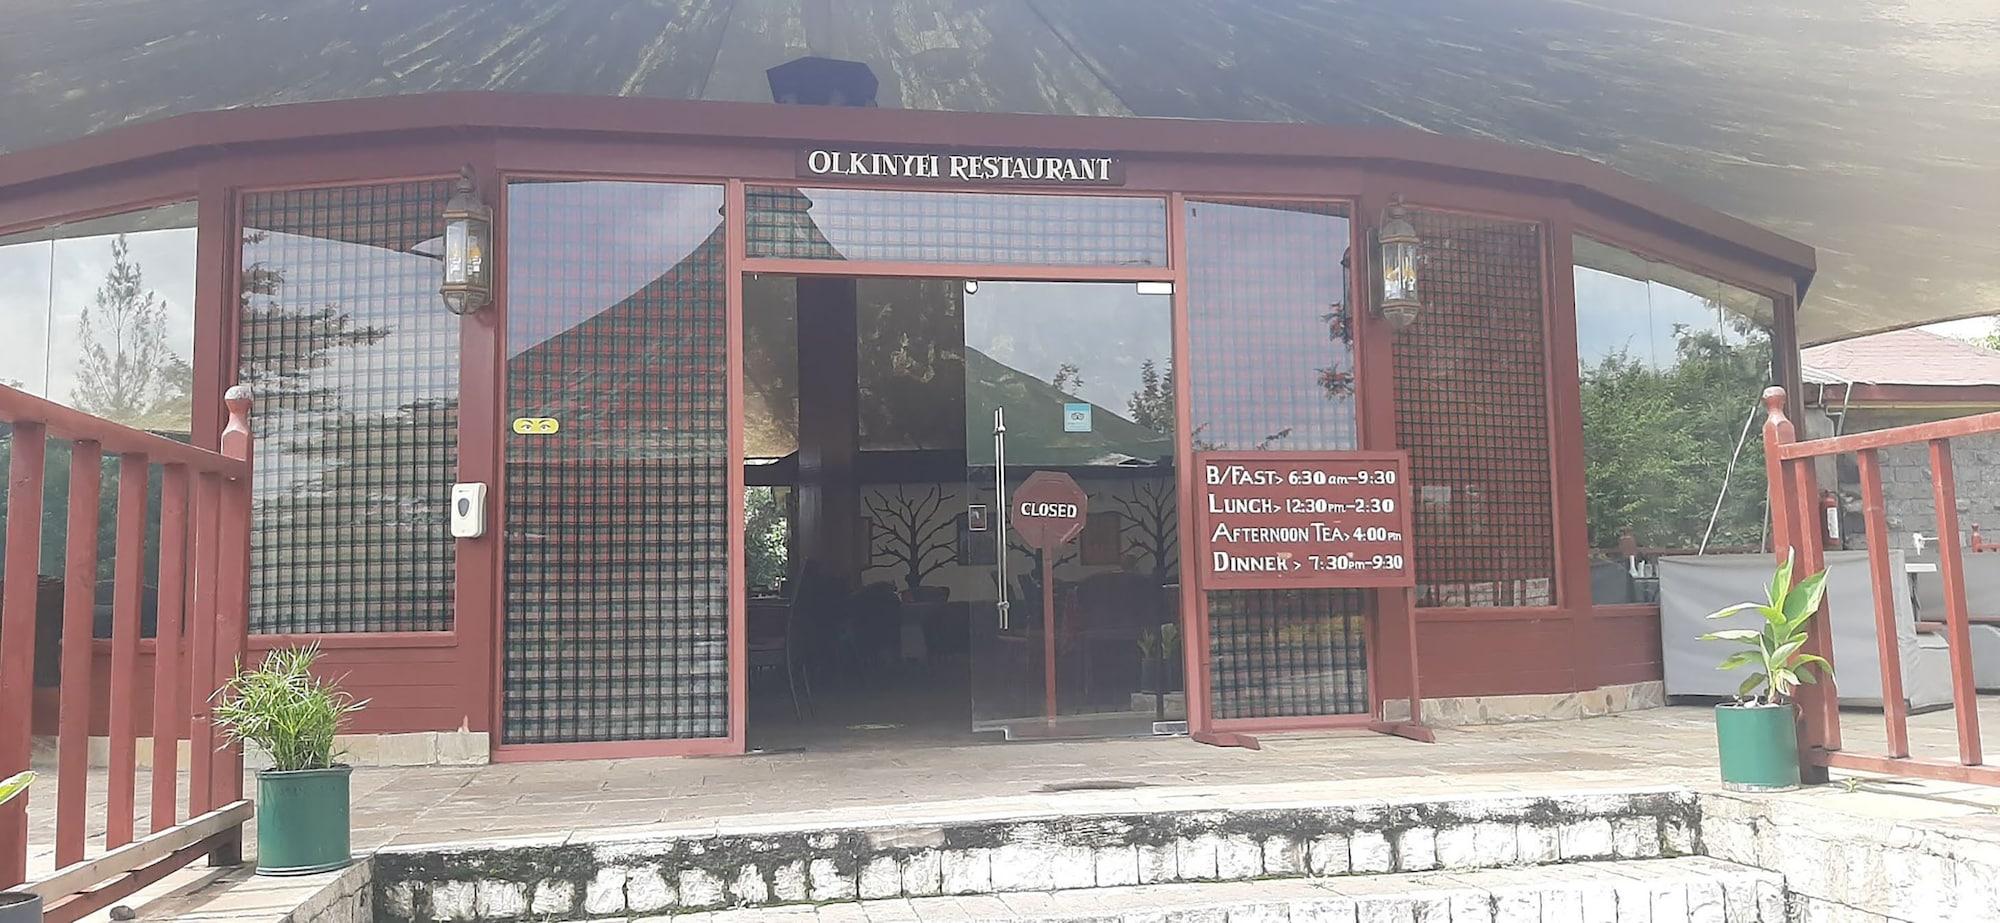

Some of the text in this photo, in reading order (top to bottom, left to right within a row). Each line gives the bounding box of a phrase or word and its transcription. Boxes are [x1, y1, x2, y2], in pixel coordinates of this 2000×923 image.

[808, 150, 1112, 181] OLKINYEI RESTAURANT
[1021, 502, 1077, 518] CLOSED
[1211, 522, 1309, 542] AFTERNOON
[1213, 551, 1288, 572] DINNER
